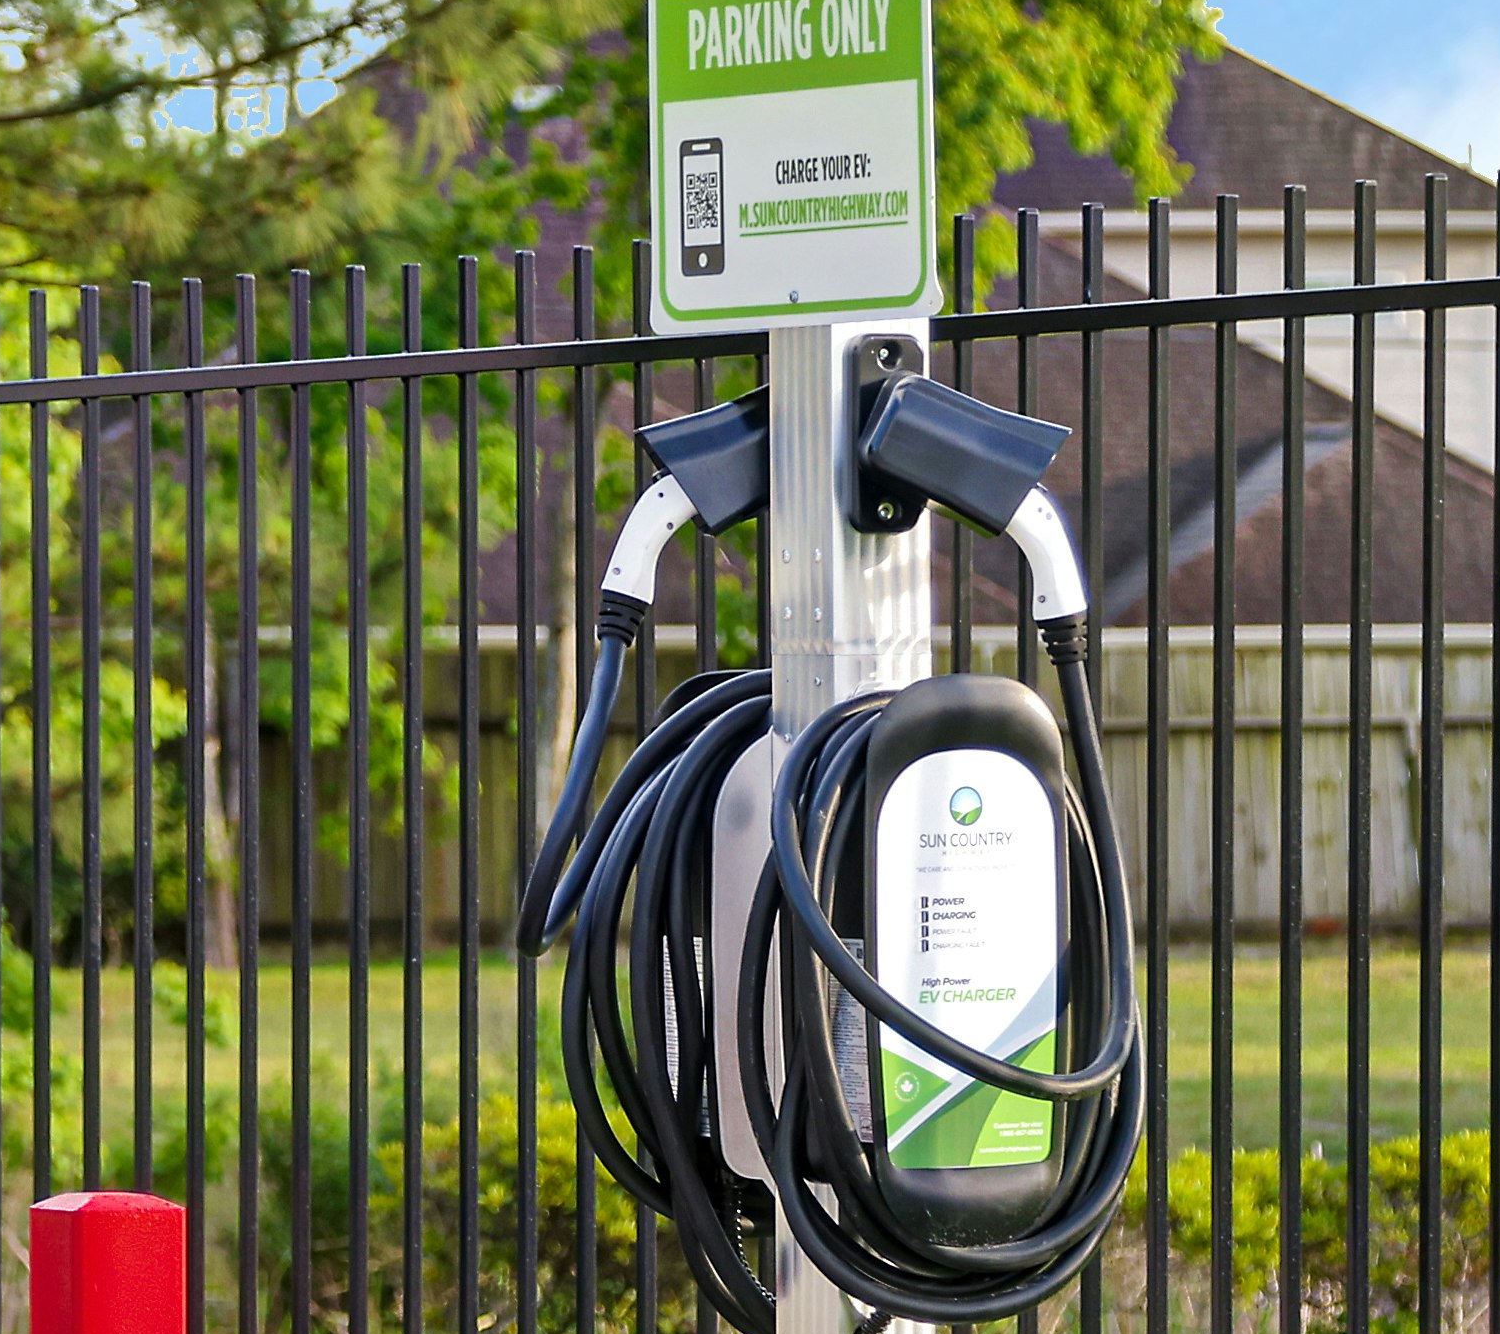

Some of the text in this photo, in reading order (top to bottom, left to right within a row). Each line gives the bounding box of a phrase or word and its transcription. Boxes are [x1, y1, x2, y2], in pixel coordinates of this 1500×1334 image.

[775, 153, 871, 185] CHARGE YOUR EV:
[739, 190, 908, 229] M.SUNCOUNTRYHIGHWAY.COM
[919, 831, 1013, 848] SUN COUNTRY
[932, 898, 965, 906] POWER
[932, 911, 976, 920] CHARGING
[922, 977, 971, 987] High Power
[919, 988, 1016, 1004] EV CHARGER
